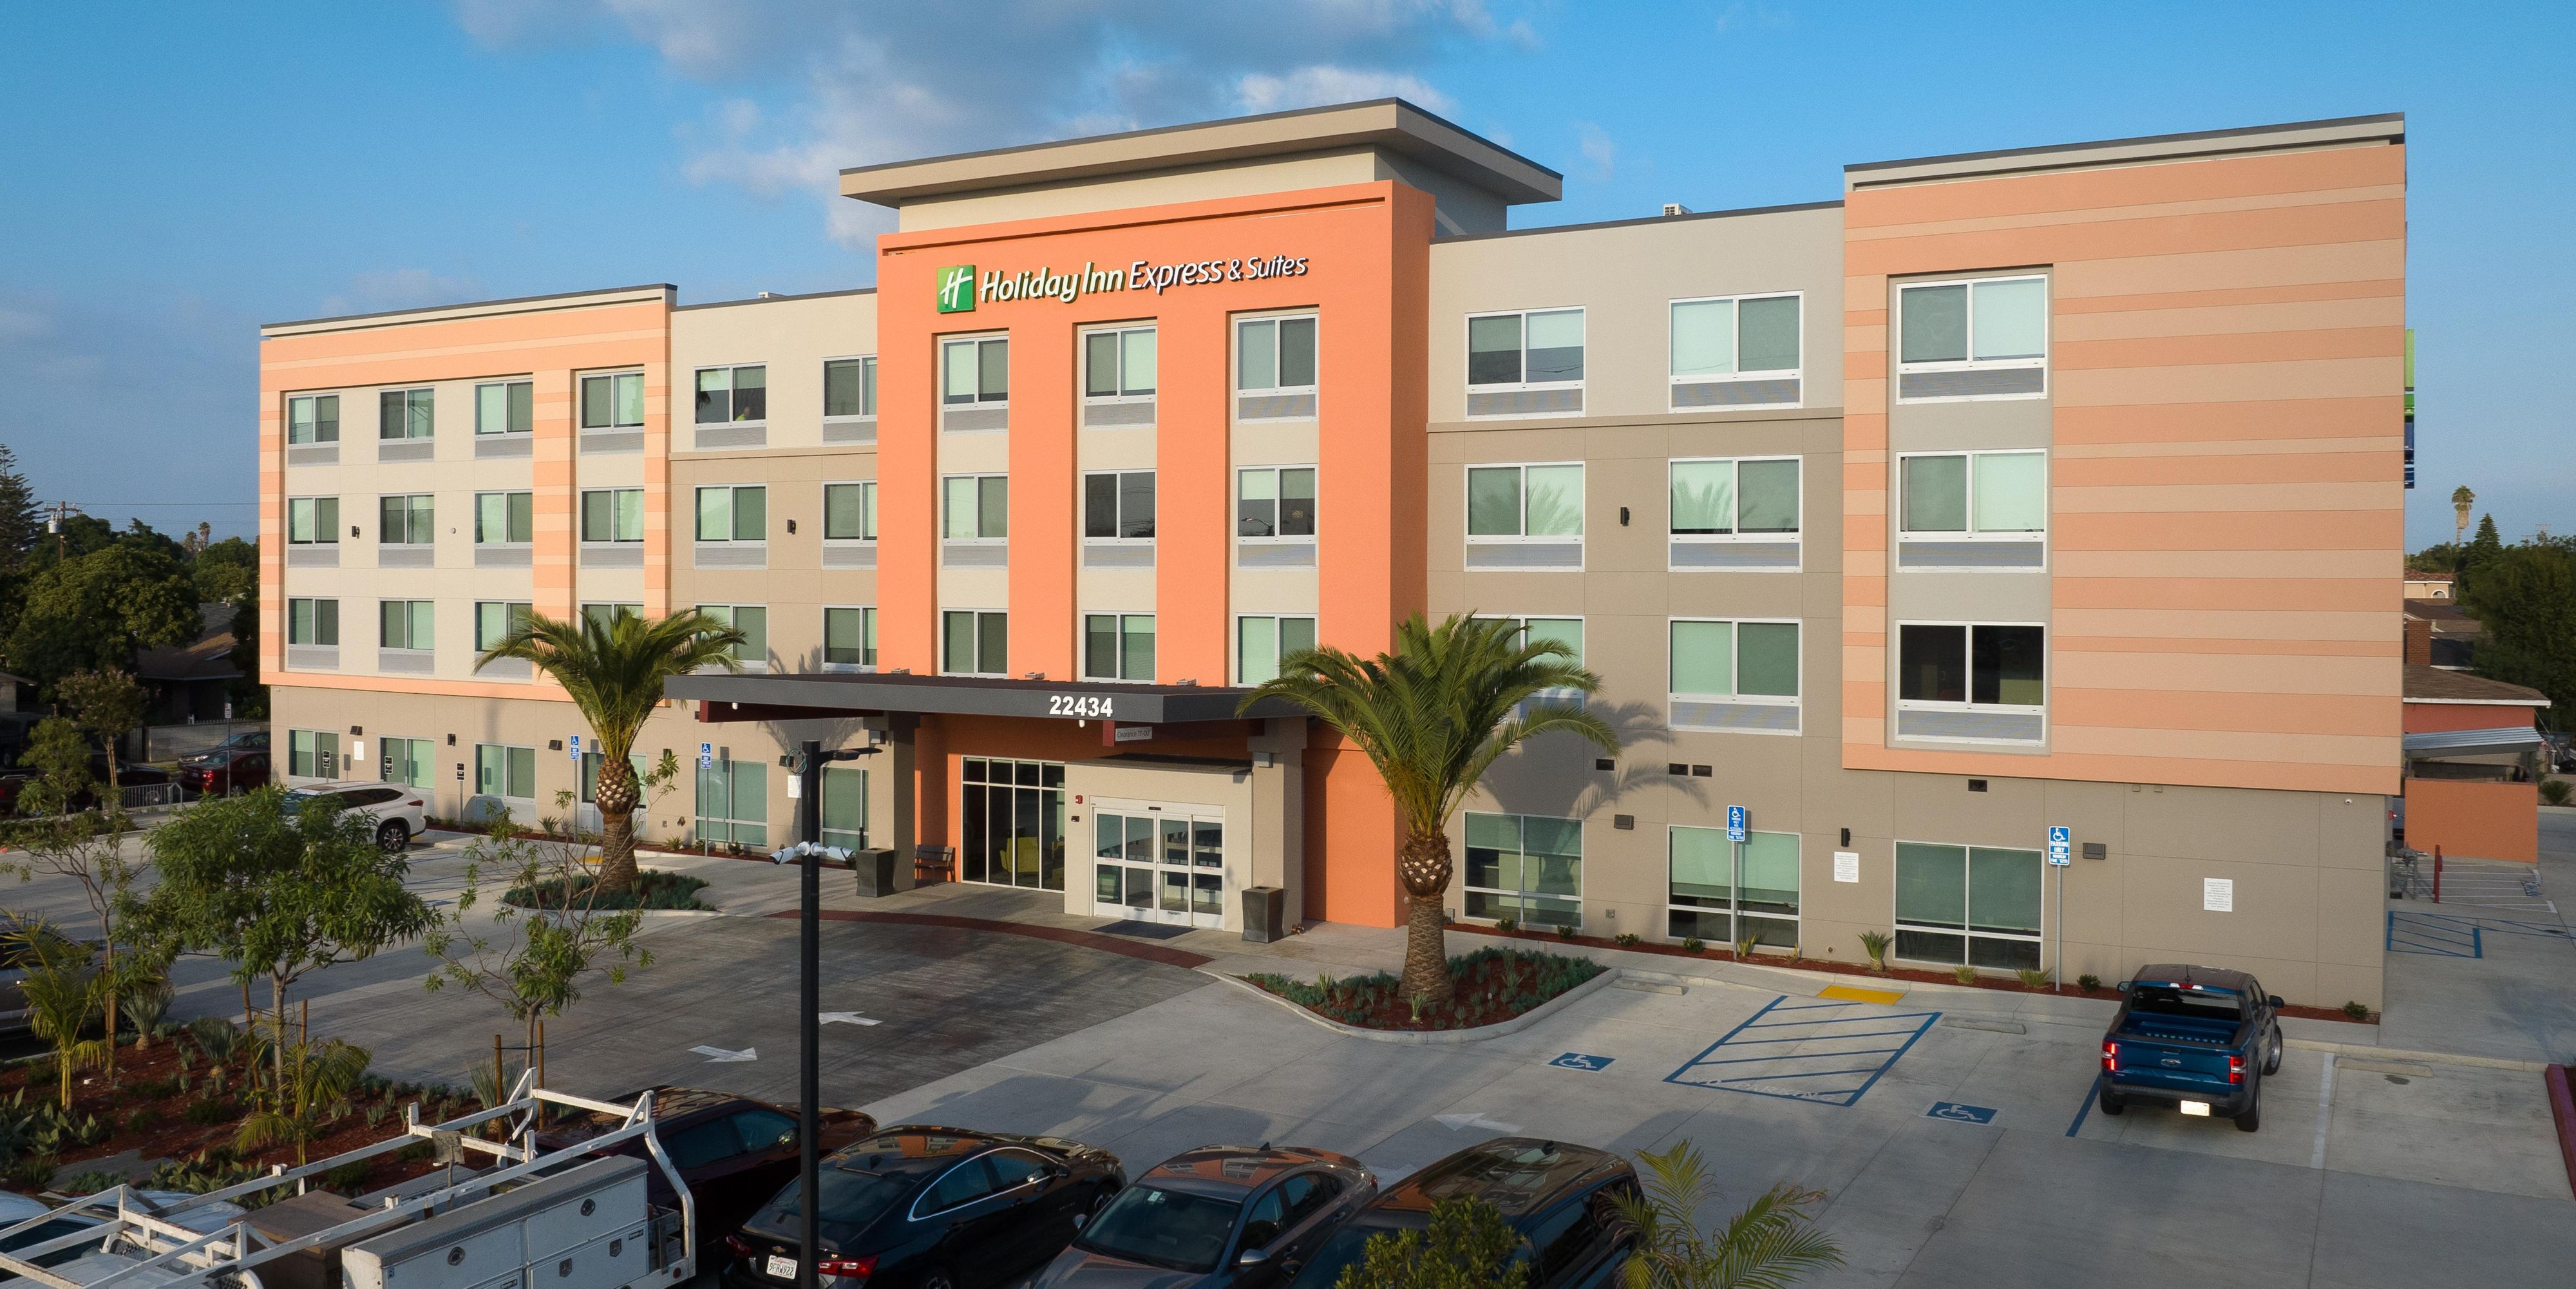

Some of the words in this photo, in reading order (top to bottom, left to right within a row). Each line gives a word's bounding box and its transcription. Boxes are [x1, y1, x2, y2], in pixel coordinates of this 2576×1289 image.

[979, 265, 1080, 303] Holiday
[1082, 261, 1125, 293] Inn
[1128, 260, 1224, 294] Express
[1227, 258, 1243, 281] &
[1245, 254, 1307, 279] Suites
[1049, 695, 1113, 717] 22434
[1117, 730, 1137, 739] Clearance
